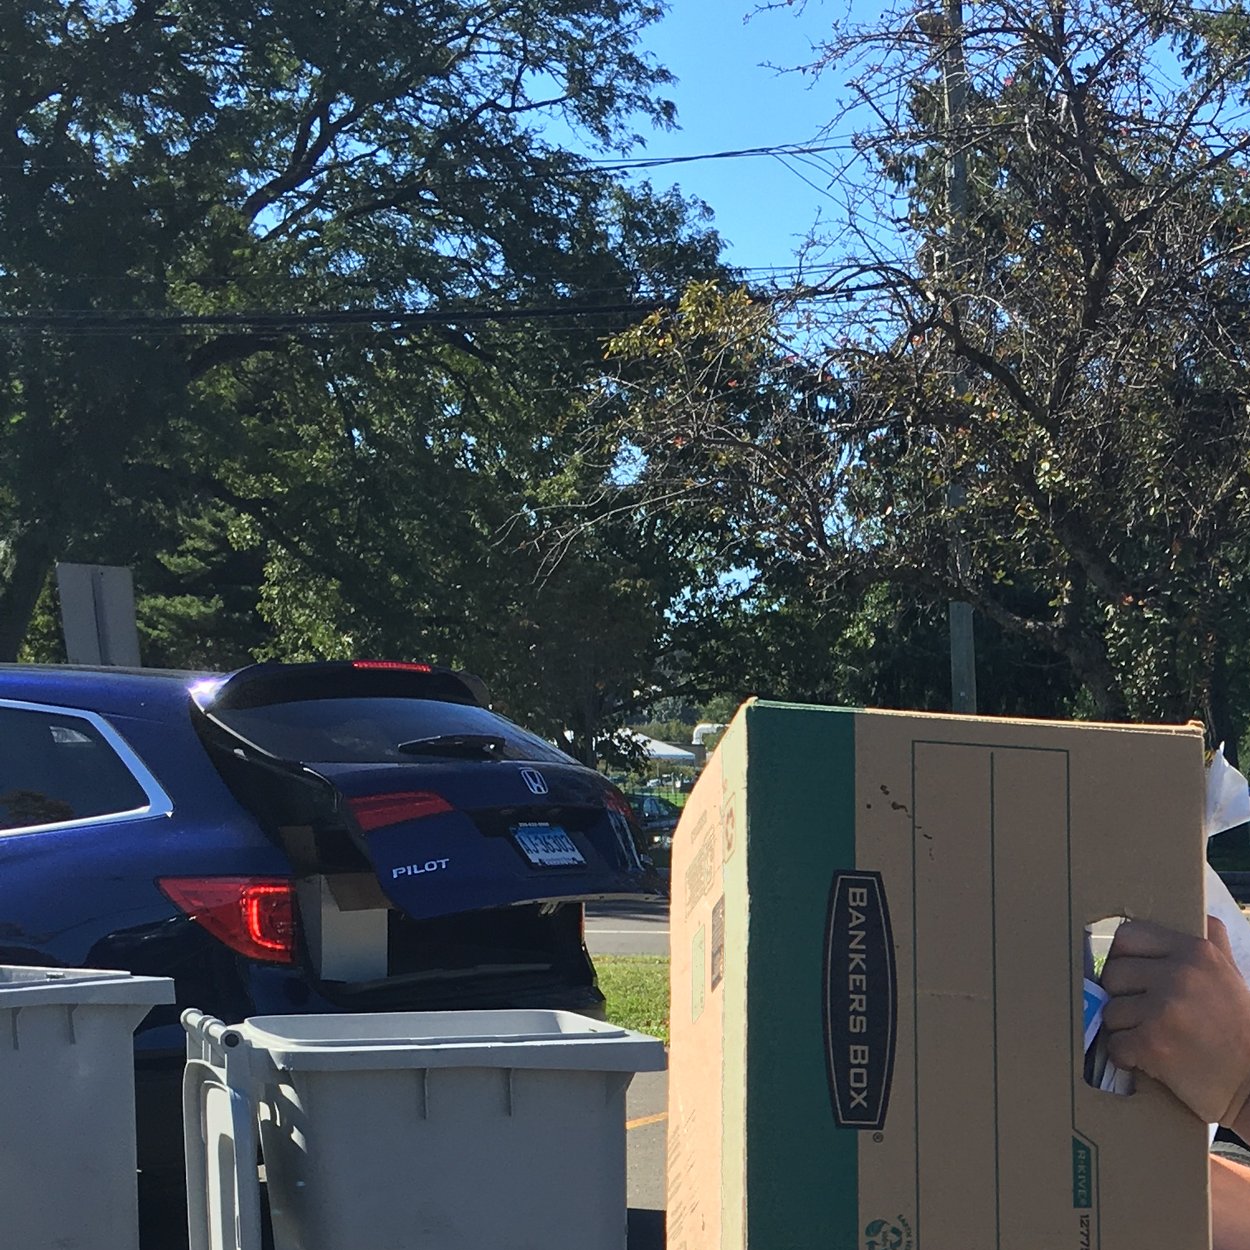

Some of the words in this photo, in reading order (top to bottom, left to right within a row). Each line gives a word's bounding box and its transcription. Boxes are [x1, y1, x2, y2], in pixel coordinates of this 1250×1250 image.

[392, 858, 450, 879] PILOT
[848, 887, 867, 1034] BANKERS
[849, 1044, 869, 1109] BOX
